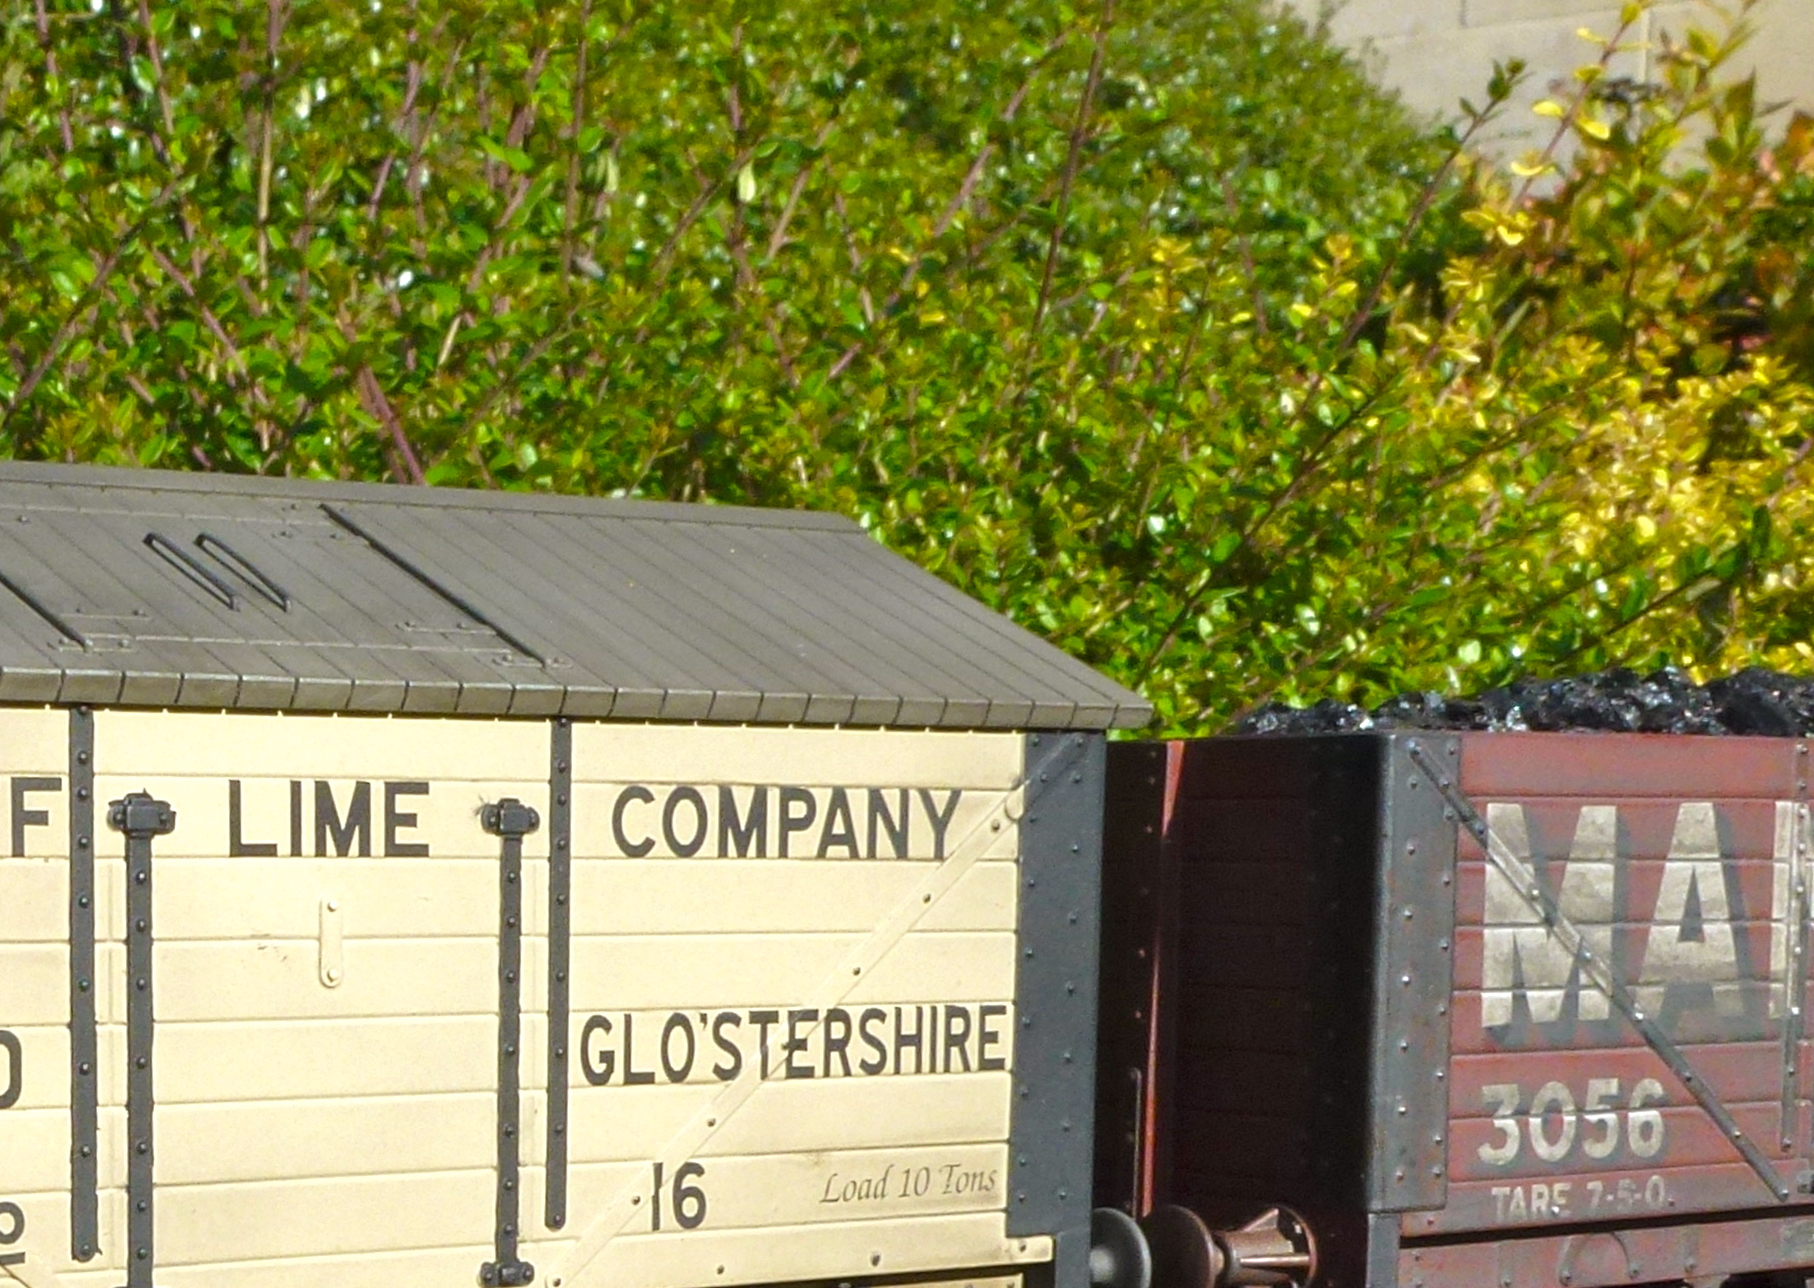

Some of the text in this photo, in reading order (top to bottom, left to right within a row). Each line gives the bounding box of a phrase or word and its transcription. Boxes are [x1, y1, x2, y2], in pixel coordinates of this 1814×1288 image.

[228, 780, 431, 857] LIME
[611, 784, 963, 860] COMPANY
[1477, 1078, 1665, 1166] 3056
[650, 1161, 707, 1232] 16
[819, 1163, 998, 1204] Load 10 Tons
[1491, 1181, 1572, 1222] TARE
